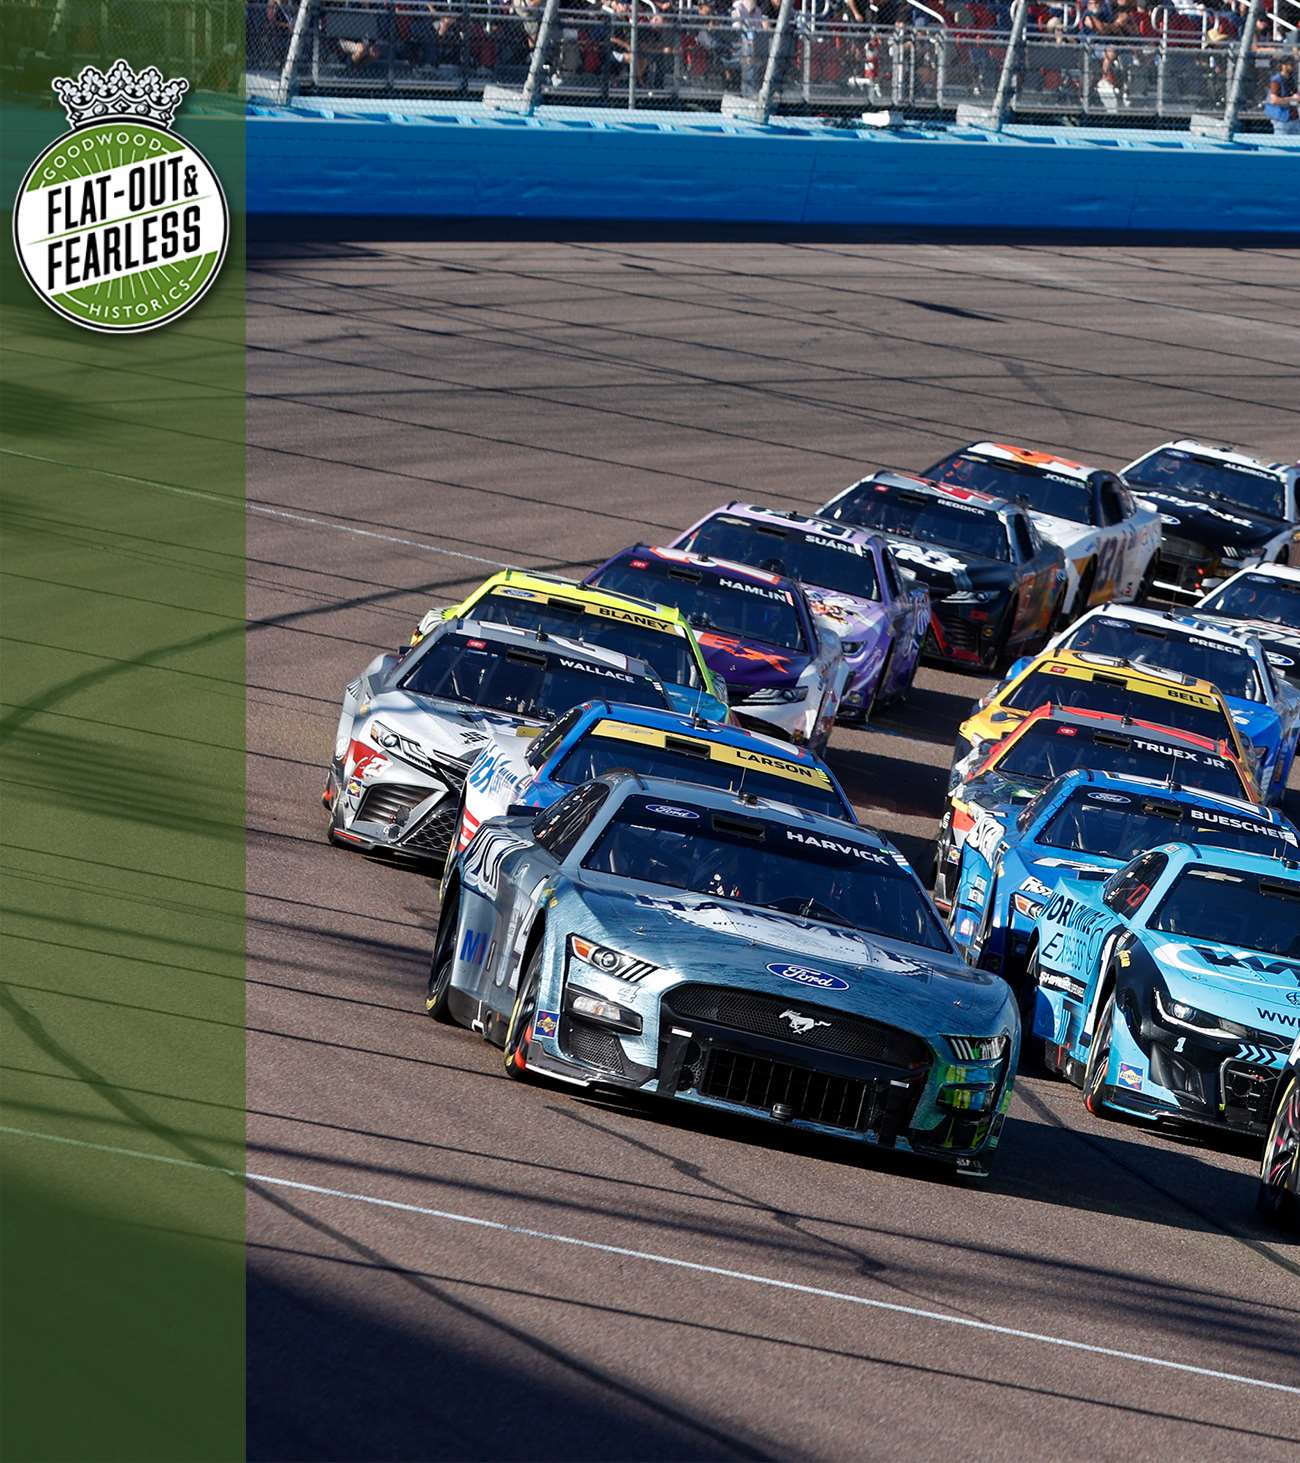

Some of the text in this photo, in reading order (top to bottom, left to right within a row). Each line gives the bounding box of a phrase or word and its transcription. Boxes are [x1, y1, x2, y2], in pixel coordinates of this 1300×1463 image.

[1042, 473, 1087, 489] JONES
[1223, 463, 1278, 482] ALMIROLA
[937, 498, 986, 516] REDDICK
[719, 578, 786, 602] HAMLIN
[599, 607, 669, 630] BLANEY
[1188, 637, 1241, 656] PREECE
[560, 658, 636, 684] WALLACE
[1167, 689, 1209, 706] BELL
[1133, 739, 1199, 762] TRUEX
[736, 750, 813, 778] LARSON
[787, 830, 889, 866] HARVICK
[780, 965, 834, 988] Ford
[1174, 1037, 1187, 1053] 1
